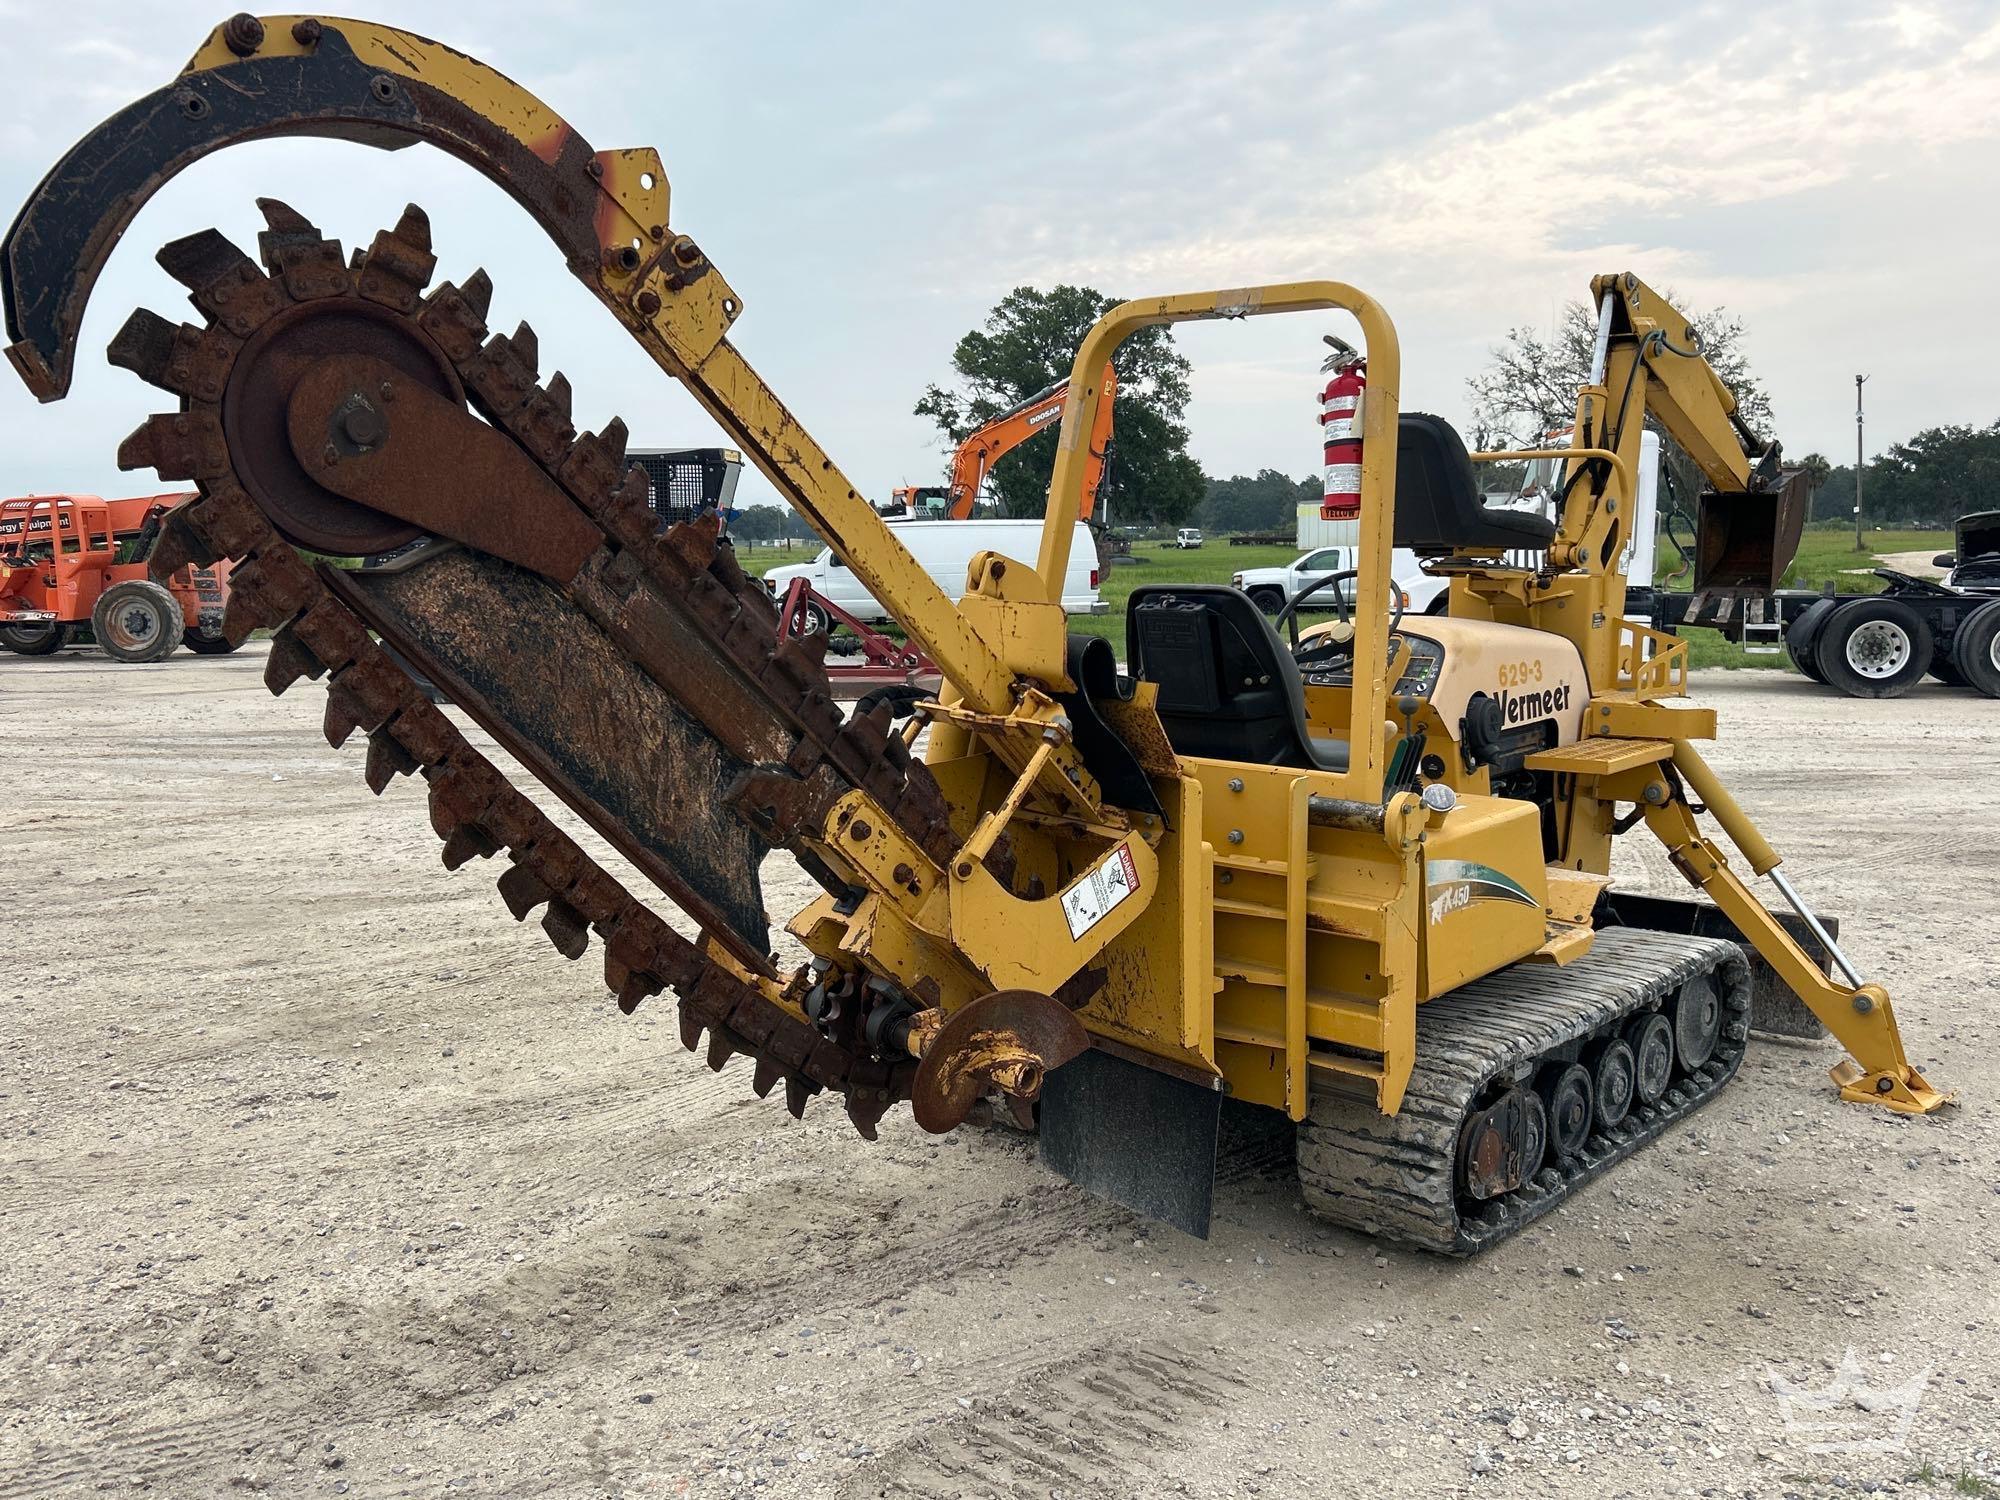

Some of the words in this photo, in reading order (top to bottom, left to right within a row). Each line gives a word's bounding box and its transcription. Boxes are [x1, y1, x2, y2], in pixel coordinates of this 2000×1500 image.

[1030, 405, 1060, 425] DOOSAN
[1326, 509, 1355, 519] YELLOW
[1499, 660, 1543, 687] 629-3
[1493, 684, 1570, 726] Vermeer
[1123, 855, 1138, 890] DANGER
